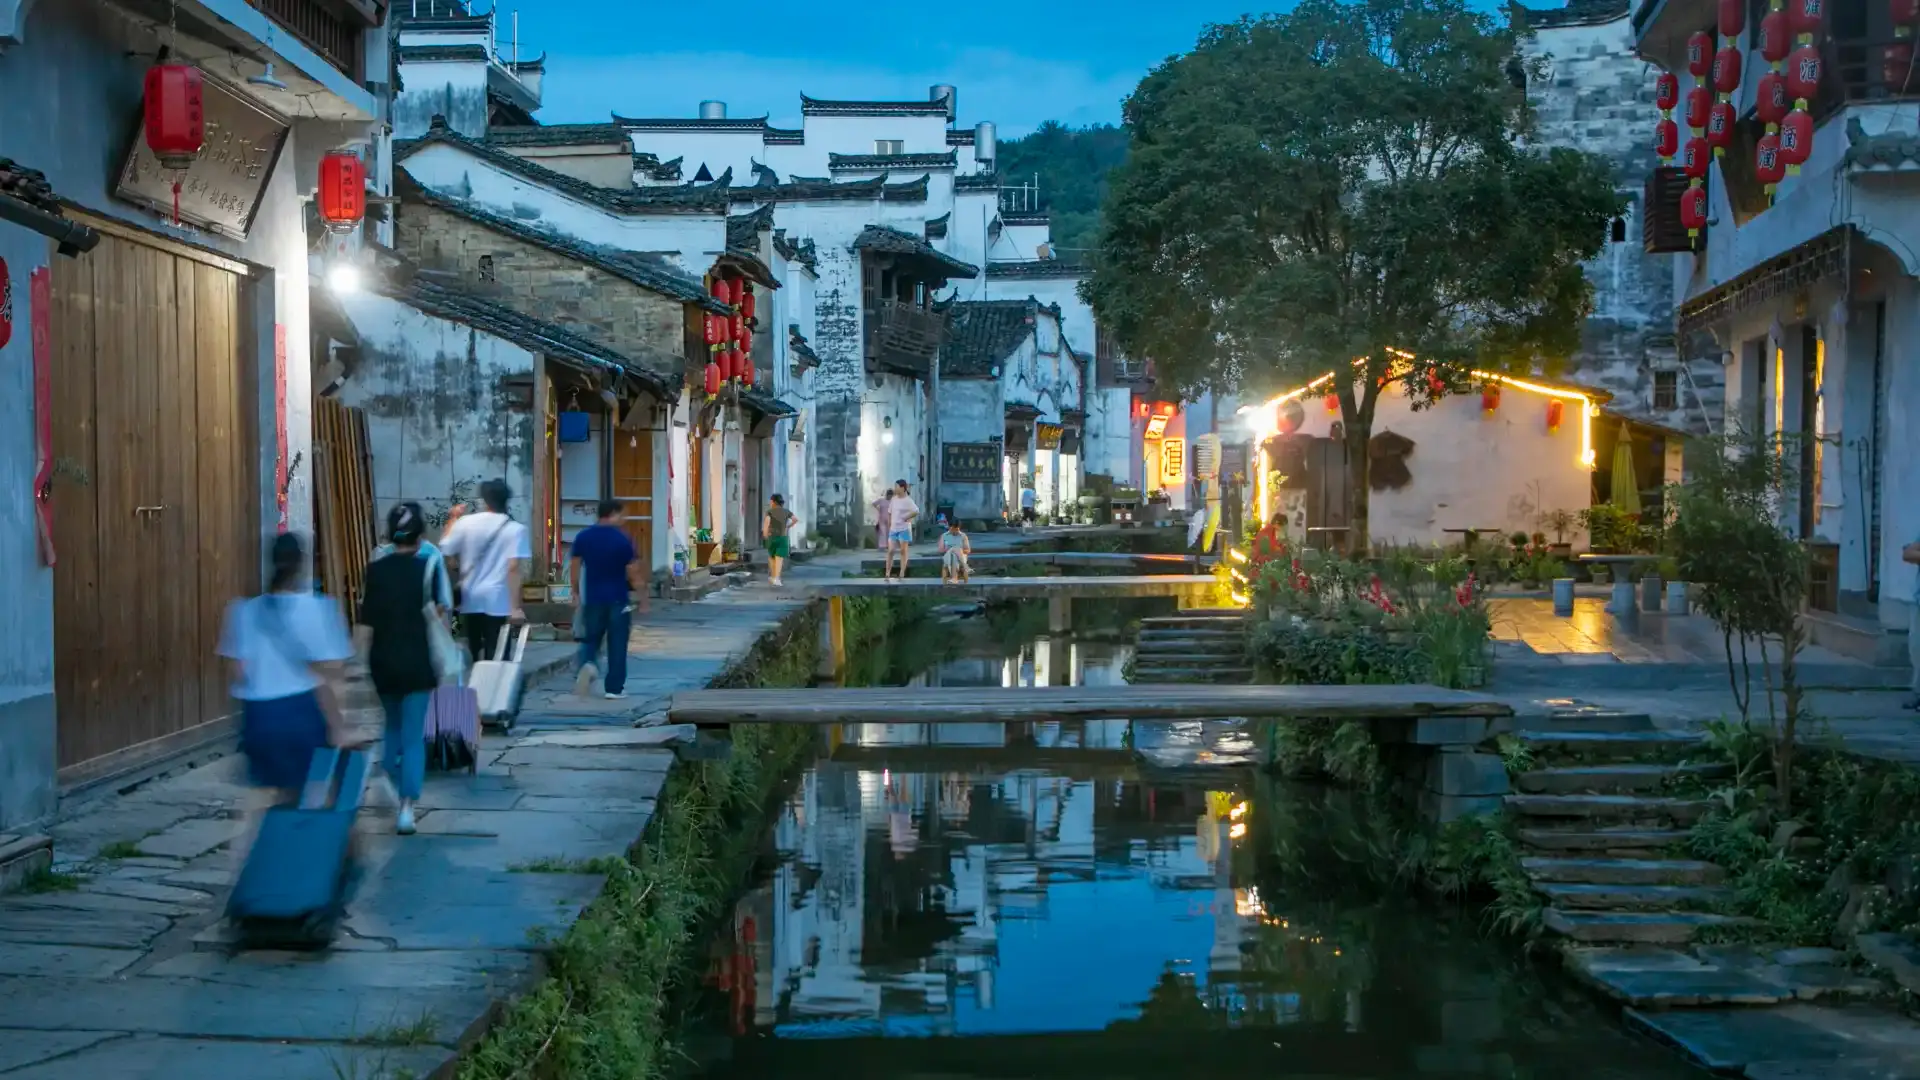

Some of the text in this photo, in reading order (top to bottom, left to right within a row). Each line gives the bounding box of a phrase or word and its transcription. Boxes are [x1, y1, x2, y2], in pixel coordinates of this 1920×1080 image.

[1800, 57, 1821, 84] 酒
[1709, 112, 1725, 134] 酒
[1780, 125, 1797, 152] 酒
[1759, 145, 1779, 170] 酒
